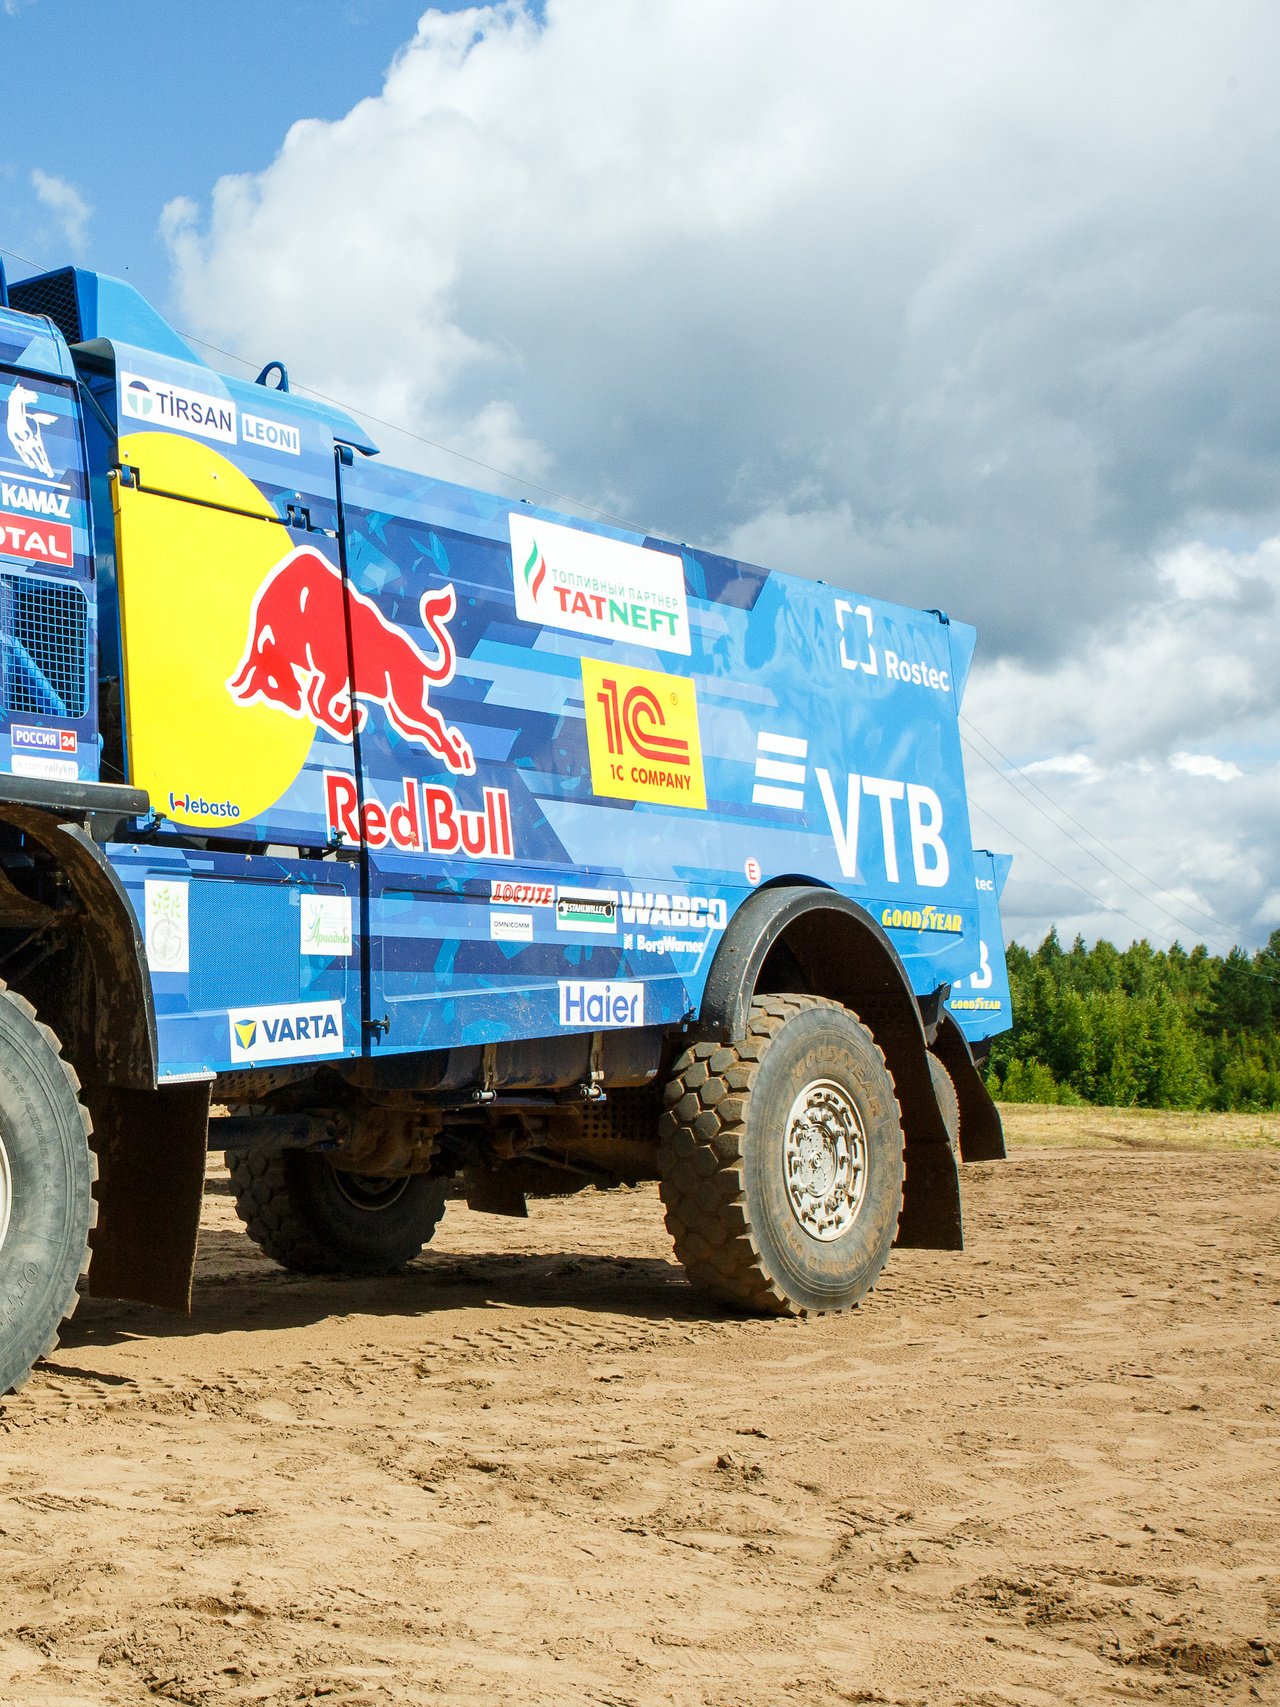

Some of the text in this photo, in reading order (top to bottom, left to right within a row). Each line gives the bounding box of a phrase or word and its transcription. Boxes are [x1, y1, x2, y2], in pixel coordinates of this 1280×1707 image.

[245, 418, 298, 450] LEONI
[1, 482, 71, 518] KAMAZ
[553, 586, 680, 637] TATNEFT
[885, 649, 950, 692] Rostec
[16, 730, 75, 748] РОССИЯ 24
[631, 766, 691, 791] COMPANY
[169, 791, 241, 819] Webasto
[815, 766, 950, 888] VTB
[492, 884, 553, 905] LOCTITE
[493, 920, 529, 929] OMNICOMM
[621, 891, 728, 930] WABCO
[882, 906, 962, 934] GOODYEAR
[637, 934, 705, 955] BorgWarner
[565, 985, 638, 1024] Haier
[951, 997, 1001, 1012] GOODYEAR
[262, 1014, 339, 1043] VARTA
